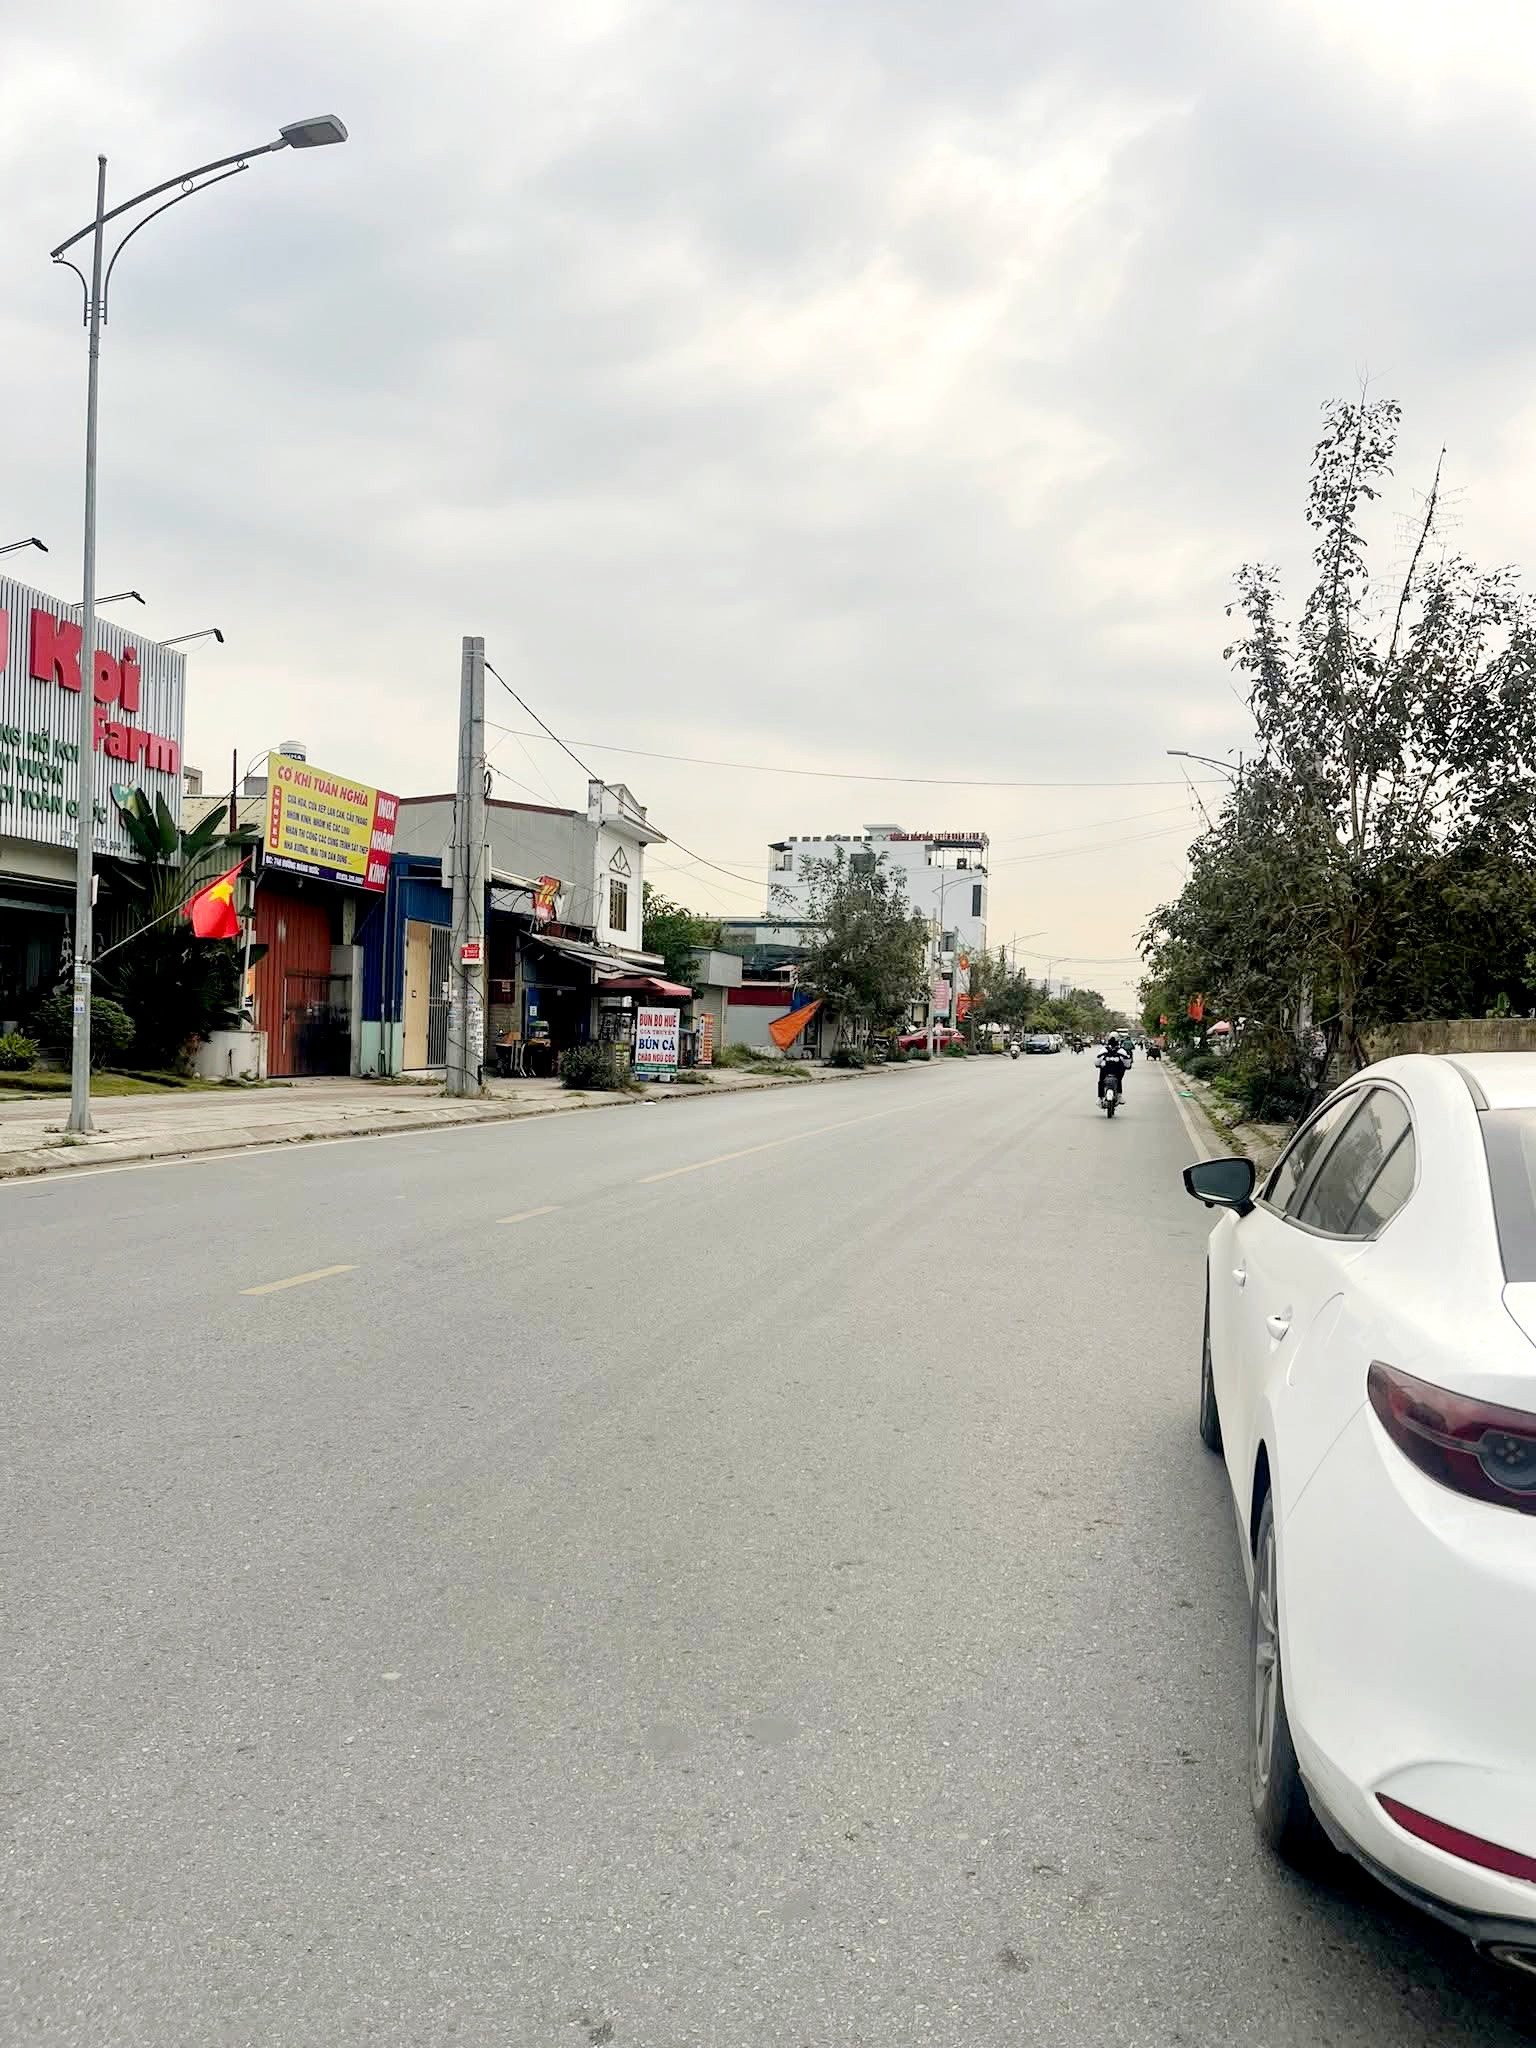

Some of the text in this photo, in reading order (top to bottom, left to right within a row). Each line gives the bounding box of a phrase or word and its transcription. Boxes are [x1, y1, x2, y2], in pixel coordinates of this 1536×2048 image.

[30, 608, 141, 712] Koi
[93, 704, 180, 775] Farm
[378, 798, 396, 821] INOX
[371, 829, 393, 852] NHÔM
[368, 860, 387, 884] KÍNH
[639, 1036, 675, 1050] BÚN CÁ
